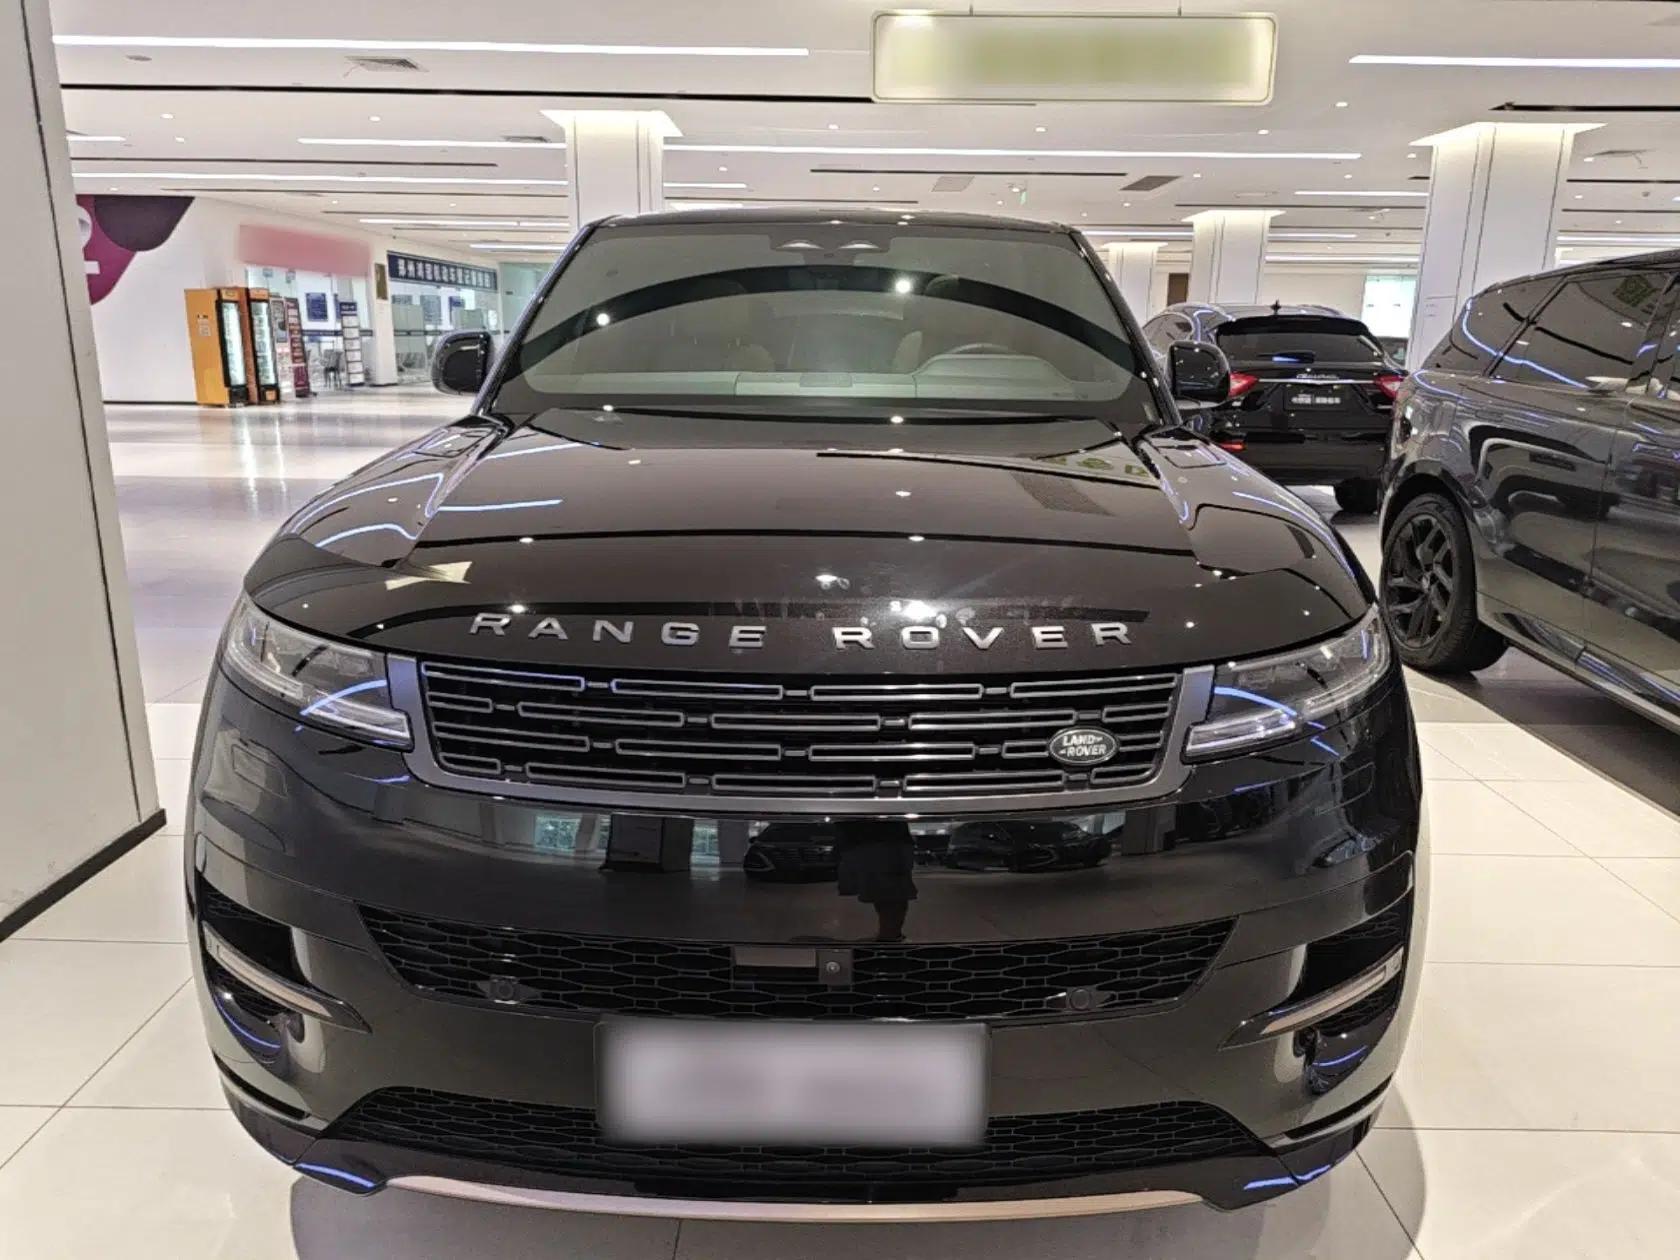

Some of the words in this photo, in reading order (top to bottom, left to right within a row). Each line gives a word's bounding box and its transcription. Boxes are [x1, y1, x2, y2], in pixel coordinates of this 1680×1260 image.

[469, 612, 767, 648] RANGE
[832, 622, 1132, 649] ROVER
[1063, 735, 1096, 746] LAND
[1066, 744, 1106, 757] ROVER
